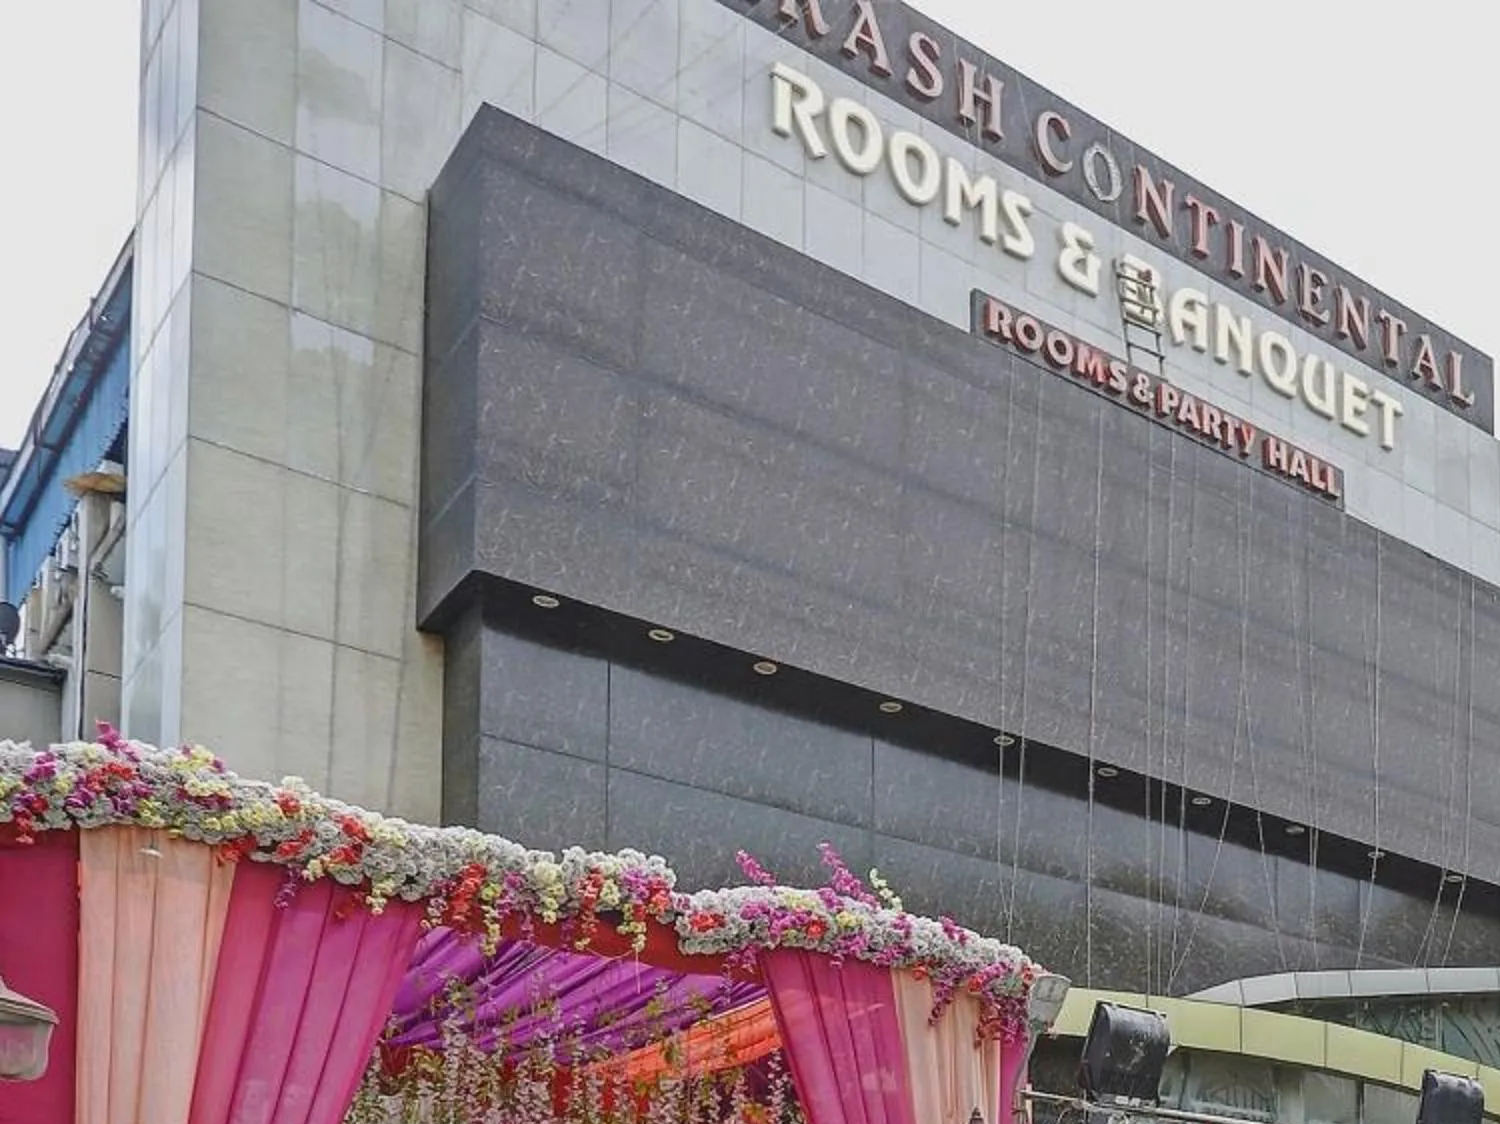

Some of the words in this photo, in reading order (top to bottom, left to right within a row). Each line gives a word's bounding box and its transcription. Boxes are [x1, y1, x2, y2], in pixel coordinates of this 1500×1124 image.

[769, 60, 1035, 259] ROOMS
[1058, 220, 1101, 298] &
[1117, 253, 1404, 451] BANQUET
[1033, 110, 1475, 408] CONTINENTAL
[1262, 435, 1342, 501] HALL
